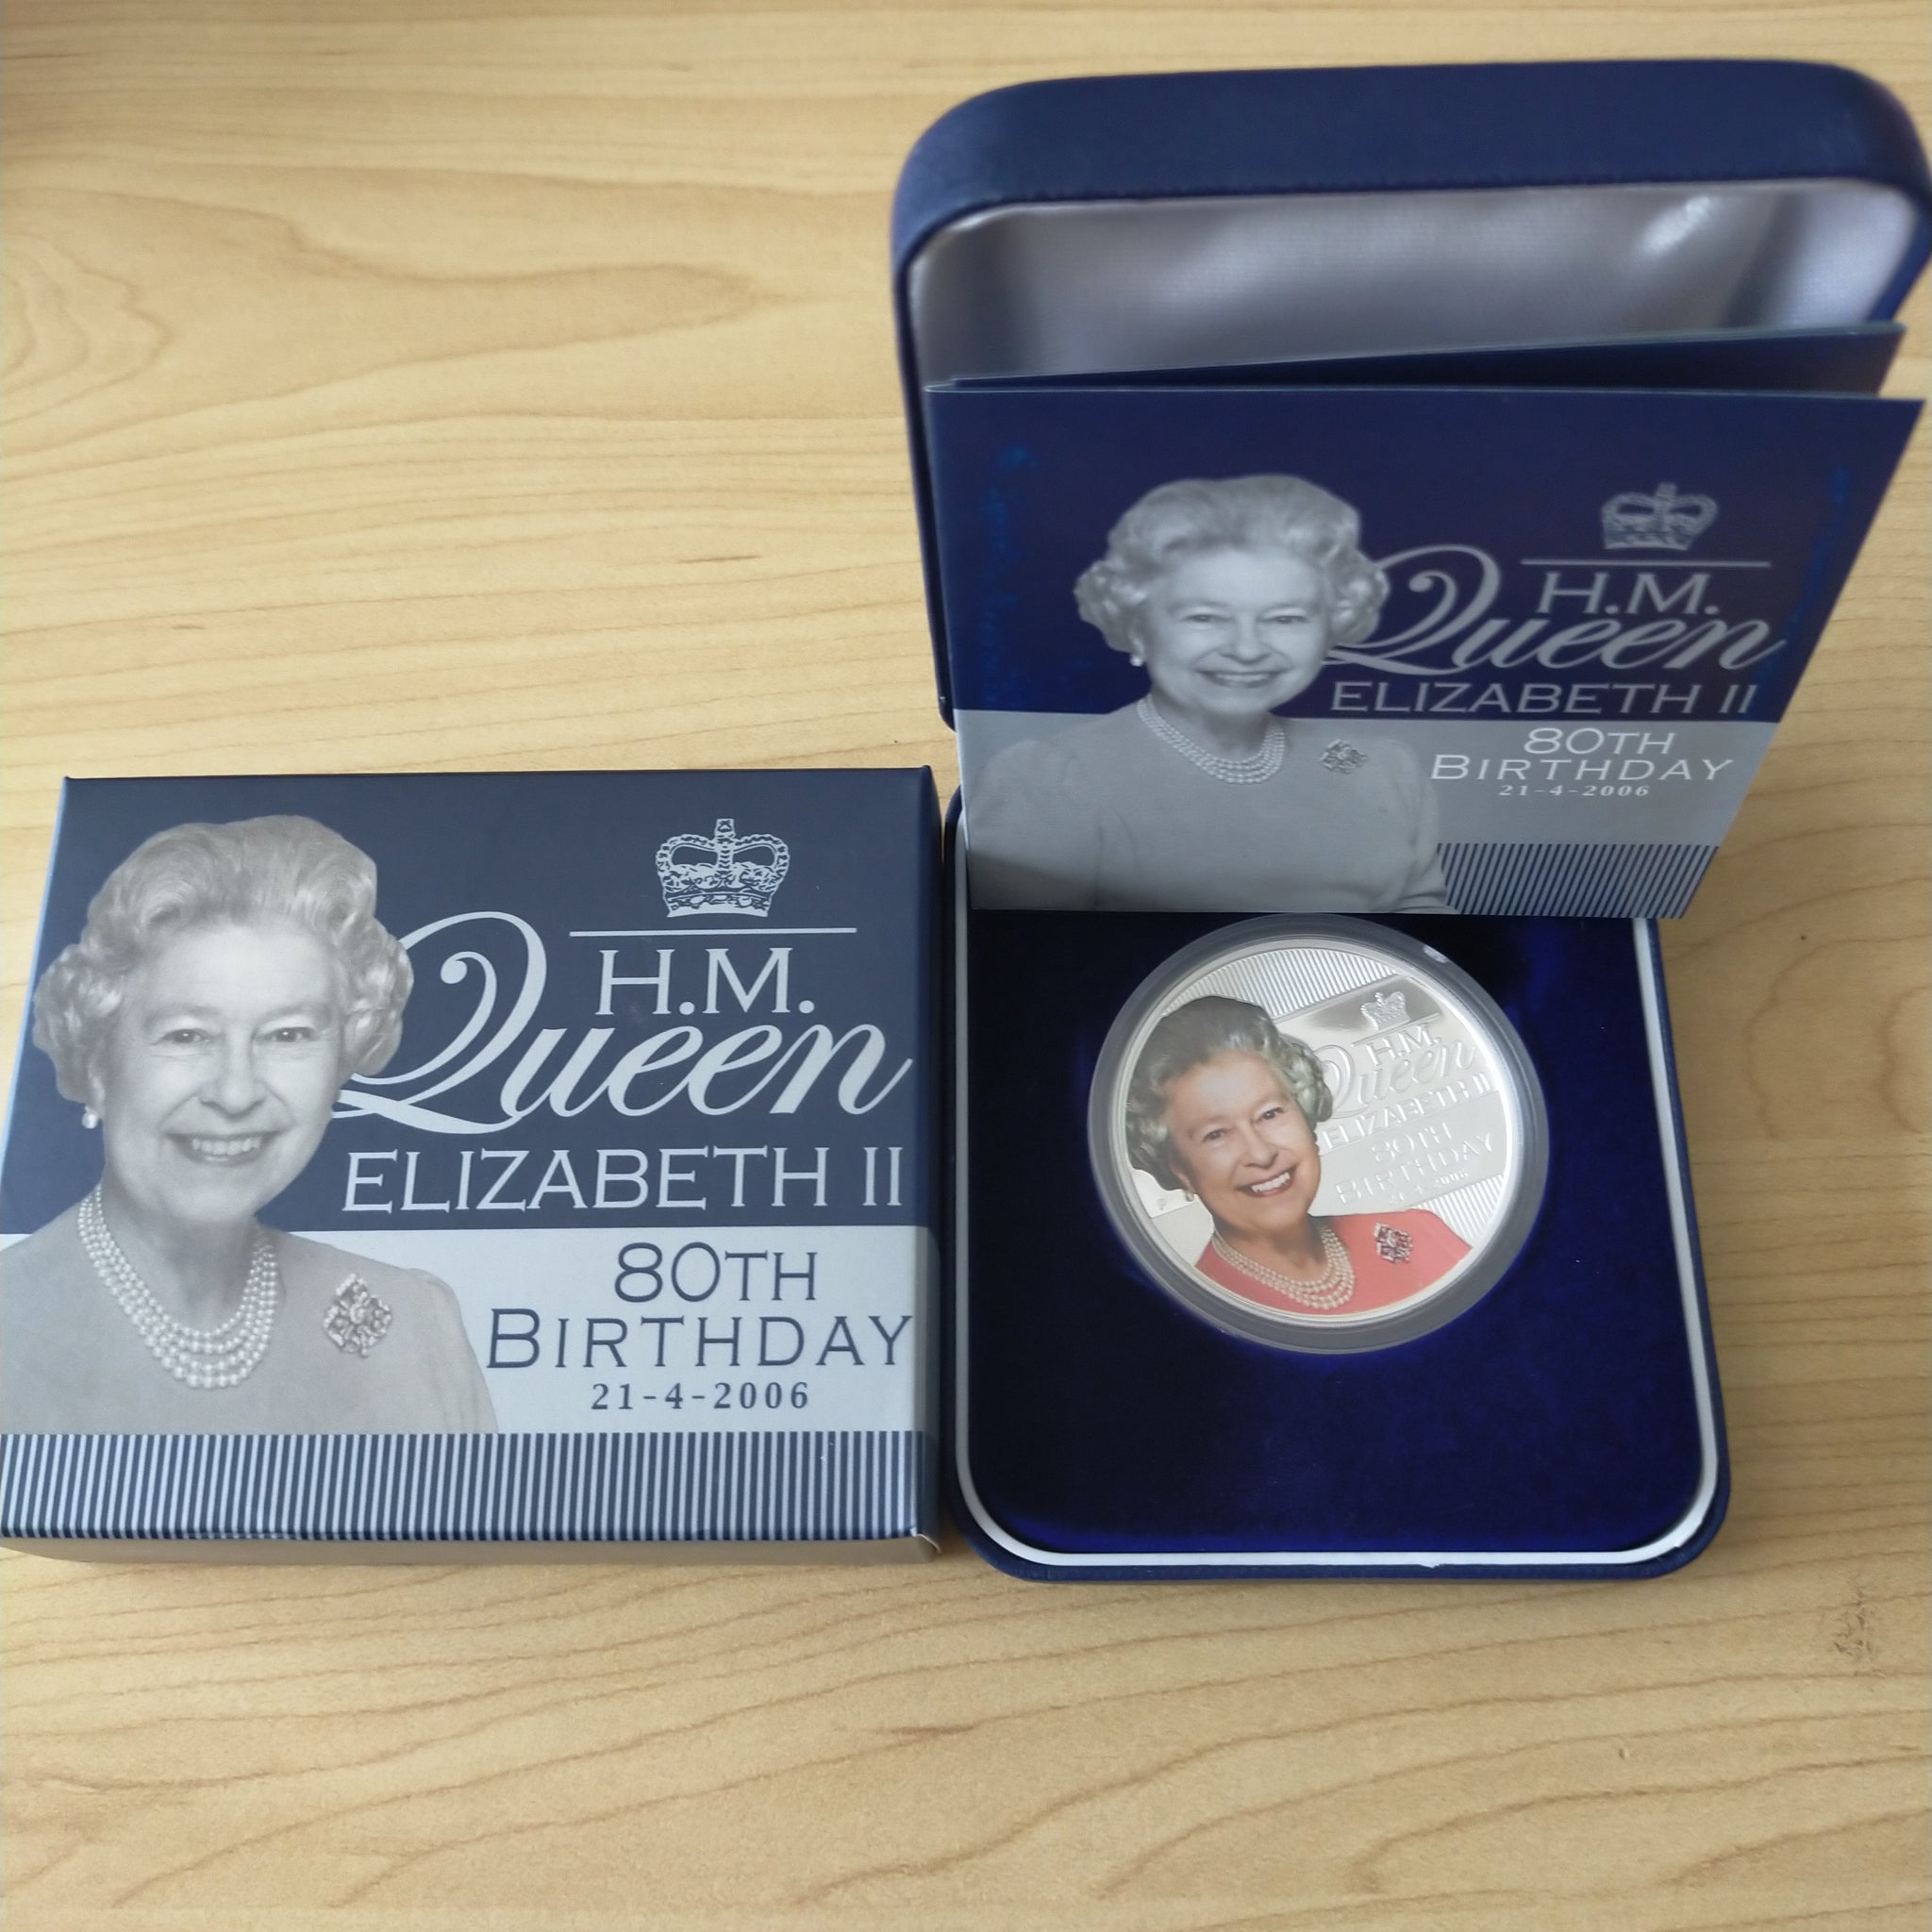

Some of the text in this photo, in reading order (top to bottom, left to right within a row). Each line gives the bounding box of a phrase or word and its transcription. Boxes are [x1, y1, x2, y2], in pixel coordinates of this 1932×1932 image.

[1322, 543, 1788, 676] Queen
[1536, 572, 1719, 615] H.M.
[1331, 681, 1757, 715] ELIZABETH II
[1430, 754, 1734, 781] BIRTHDAY
[1524, 727, 1675, 755] 80TH
[1499, 785, 1650, 797] 21-4-2006
[595, 947, 815, 1014] H.M.
[332, 911, 912, 1134] Queen
[1366, 1023, 1441, 1066] H.M.
[1314, 1043, 1477, 1120] Queen
[1323, 1080, 1470, 1149] ELIZABETH
[1371, 1122, 1453, 1163] 80TH
[341, 1145, 903, 1212] ELIZABETH II
[1336, 1133, 1493, 1204] BIRTHDAY
[614, 1241, 818, 1303] 80TH
[486, 1307, 913, 1369] BIRTHDAY
[591, 1382, 809, 1409] 21-4-2006
